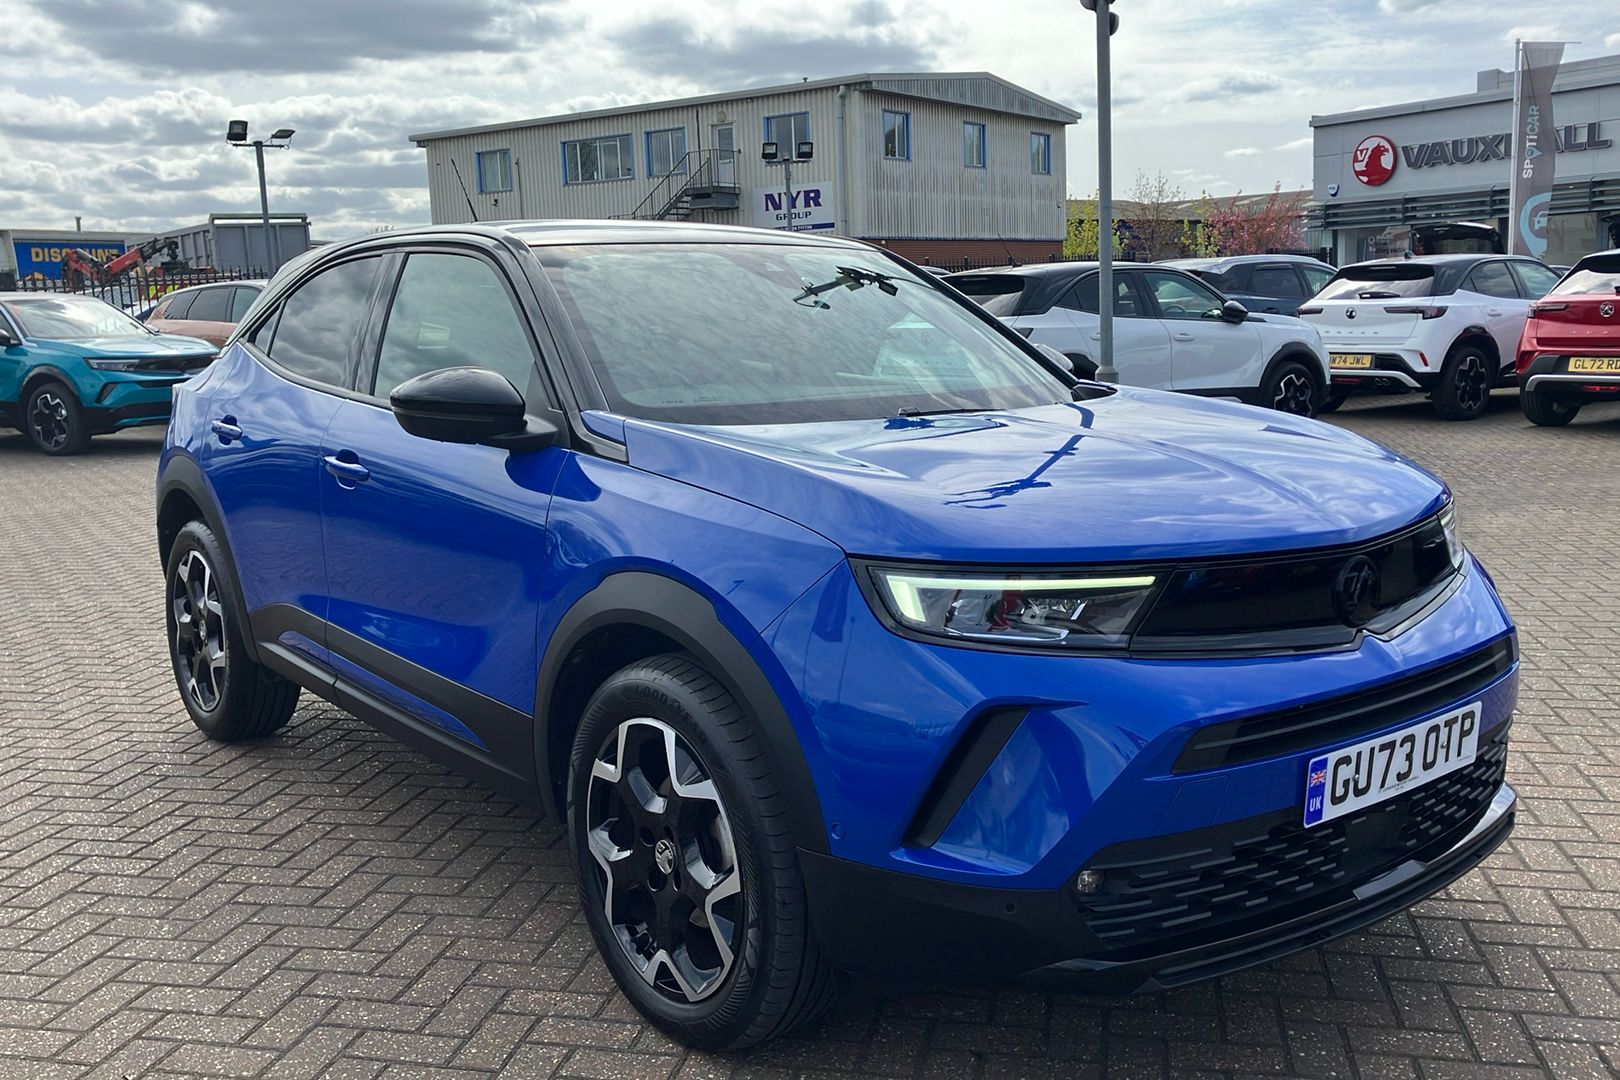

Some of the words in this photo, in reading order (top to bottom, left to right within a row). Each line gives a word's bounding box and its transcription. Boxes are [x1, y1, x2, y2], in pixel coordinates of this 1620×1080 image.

[1401, 121, 1612, 169] VAUXLL
[764, 188, 822, 212] NYR
[1329, 354, 1348, 366] W74
[1574, 358, 1604, 370] GL72
[1330, 733, 1416, 806] GU73
[1422, 709, 1476, 772] OTP
[1309, 795, 1322, 812] UK
